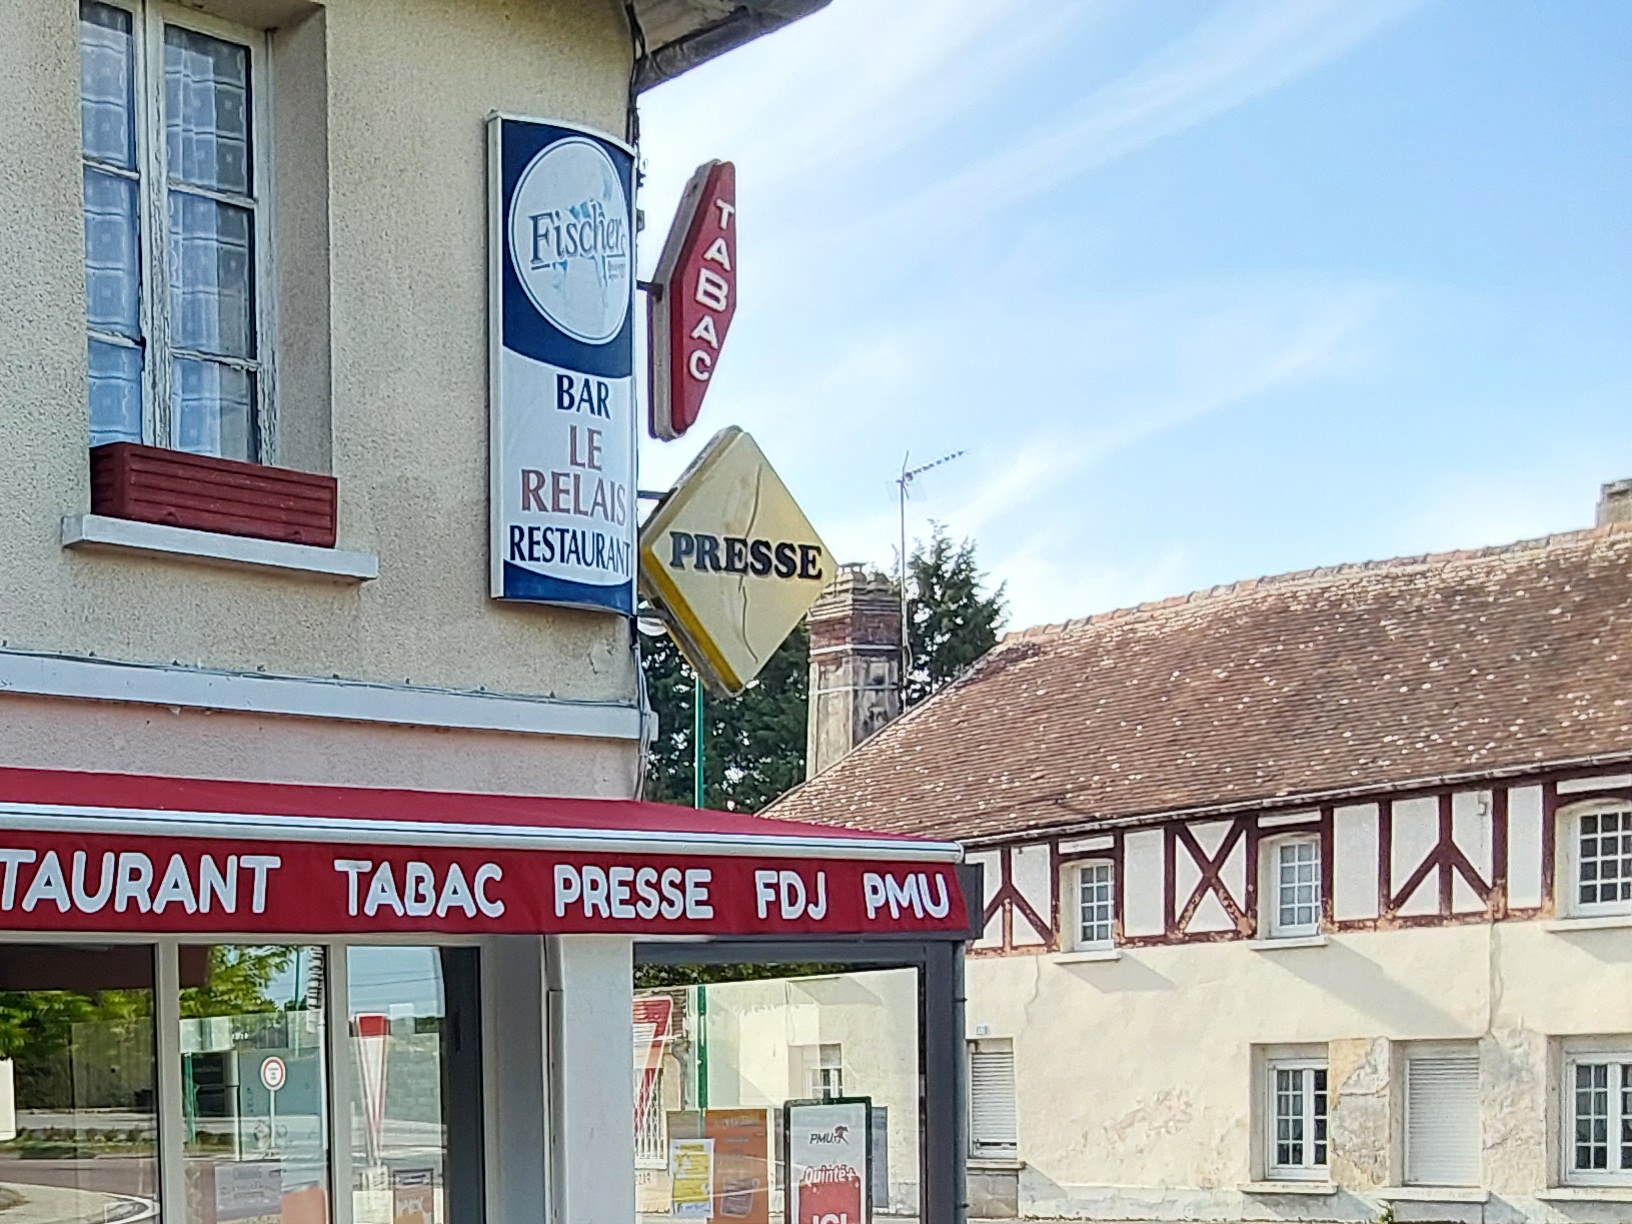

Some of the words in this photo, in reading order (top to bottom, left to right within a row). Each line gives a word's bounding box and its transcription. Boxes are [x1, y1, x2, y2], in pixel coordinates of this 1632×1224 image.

[528, 203, 622, 265] Fischer
[689, 198, 735, 381] TABAC
[556, 374, 610, 420] BAR
[570, 425, 602, 470] LE
[521, 469, 626, 526] RELAIS
[510, 525, 630, 577] RESTAURANT
[670, 531, 823, 580] PRESSE
[334, 859, 504, 918] TABAC
[554, 864, 714, 920] PRESSE
[756, 870, 826, 921] FDJ
[866, 872, 949, 919] PMU
[810, 1133, 833, 1144] PMU
